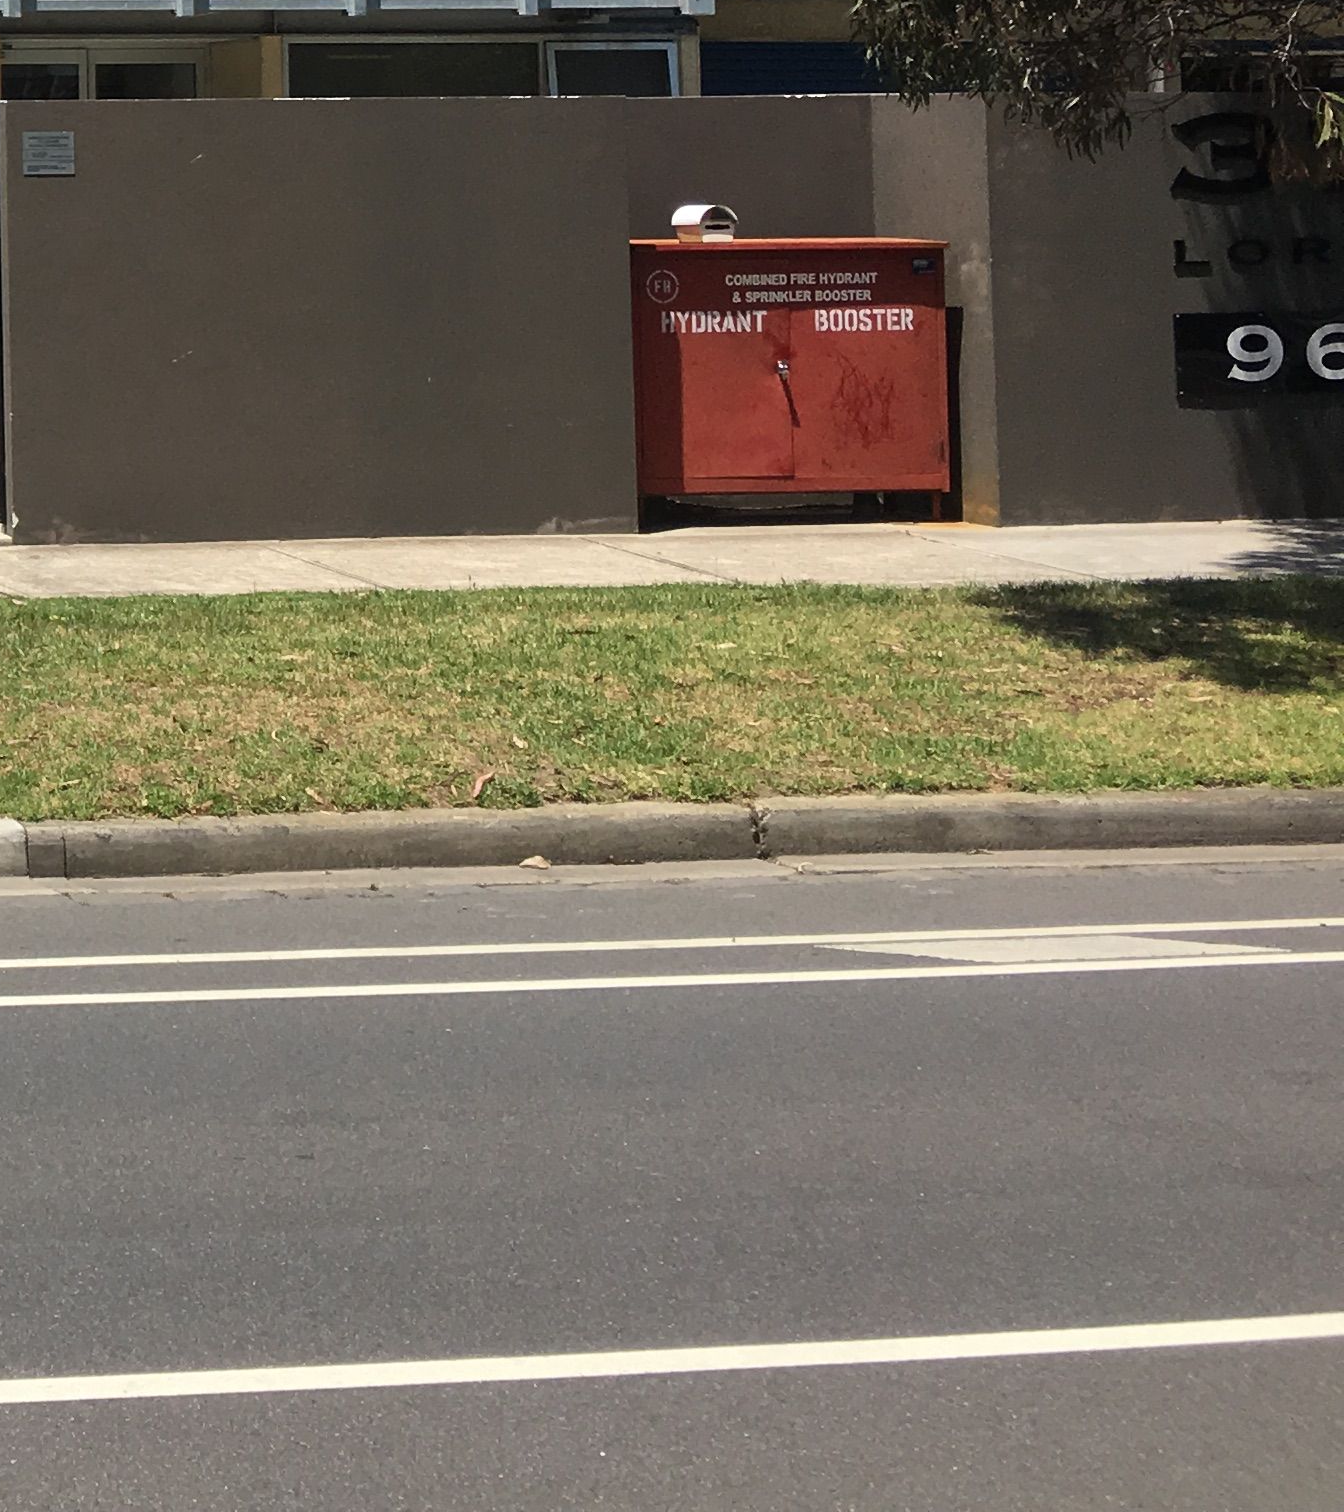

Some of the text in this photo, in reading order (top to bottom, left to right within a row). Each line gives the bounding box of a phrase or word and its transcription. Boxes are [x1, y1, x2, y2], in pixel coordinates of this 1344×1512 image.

[725, 272, 878, 286] COMBINED FIRE HYDRANT
[732, 289, 872, 303] & SPRINKLER BOOSTER
[662, 308, 915, 334] HYDRANT BOOSTER
[1226, 322, 1344, 382] 96
